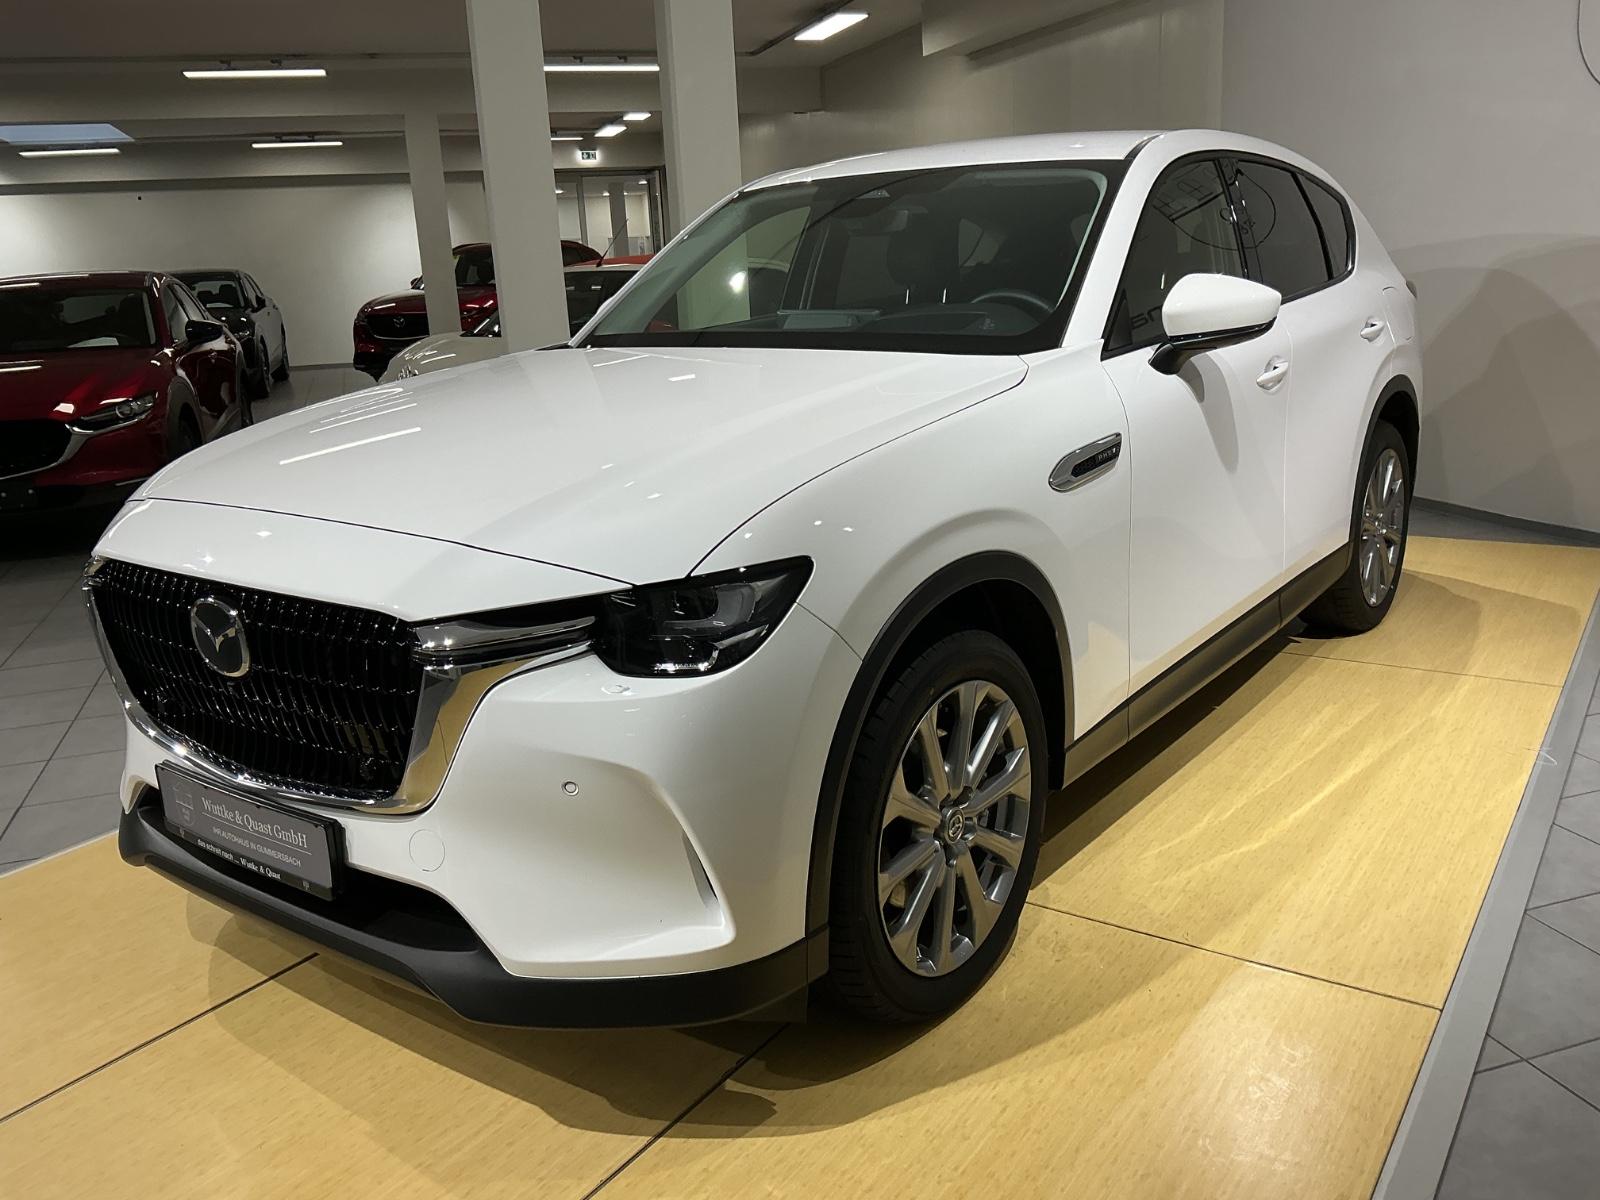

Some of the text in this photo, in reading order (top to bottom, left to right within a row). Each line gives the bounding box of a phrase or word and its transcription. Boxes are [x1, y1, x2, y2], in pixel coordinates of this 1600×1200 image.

[202, 797, 307, 848] Wuttke & Quast GmbH
[222, 831, 249, 848] AUTOHAUS
[250, 842, 256, 850] IN
[256, 844, 301, 867] GUMMERSBACH
[222, 851, 233, 860] nach
[259, 866, 264, 874] &
[265, 868, 281, 879] Quast
